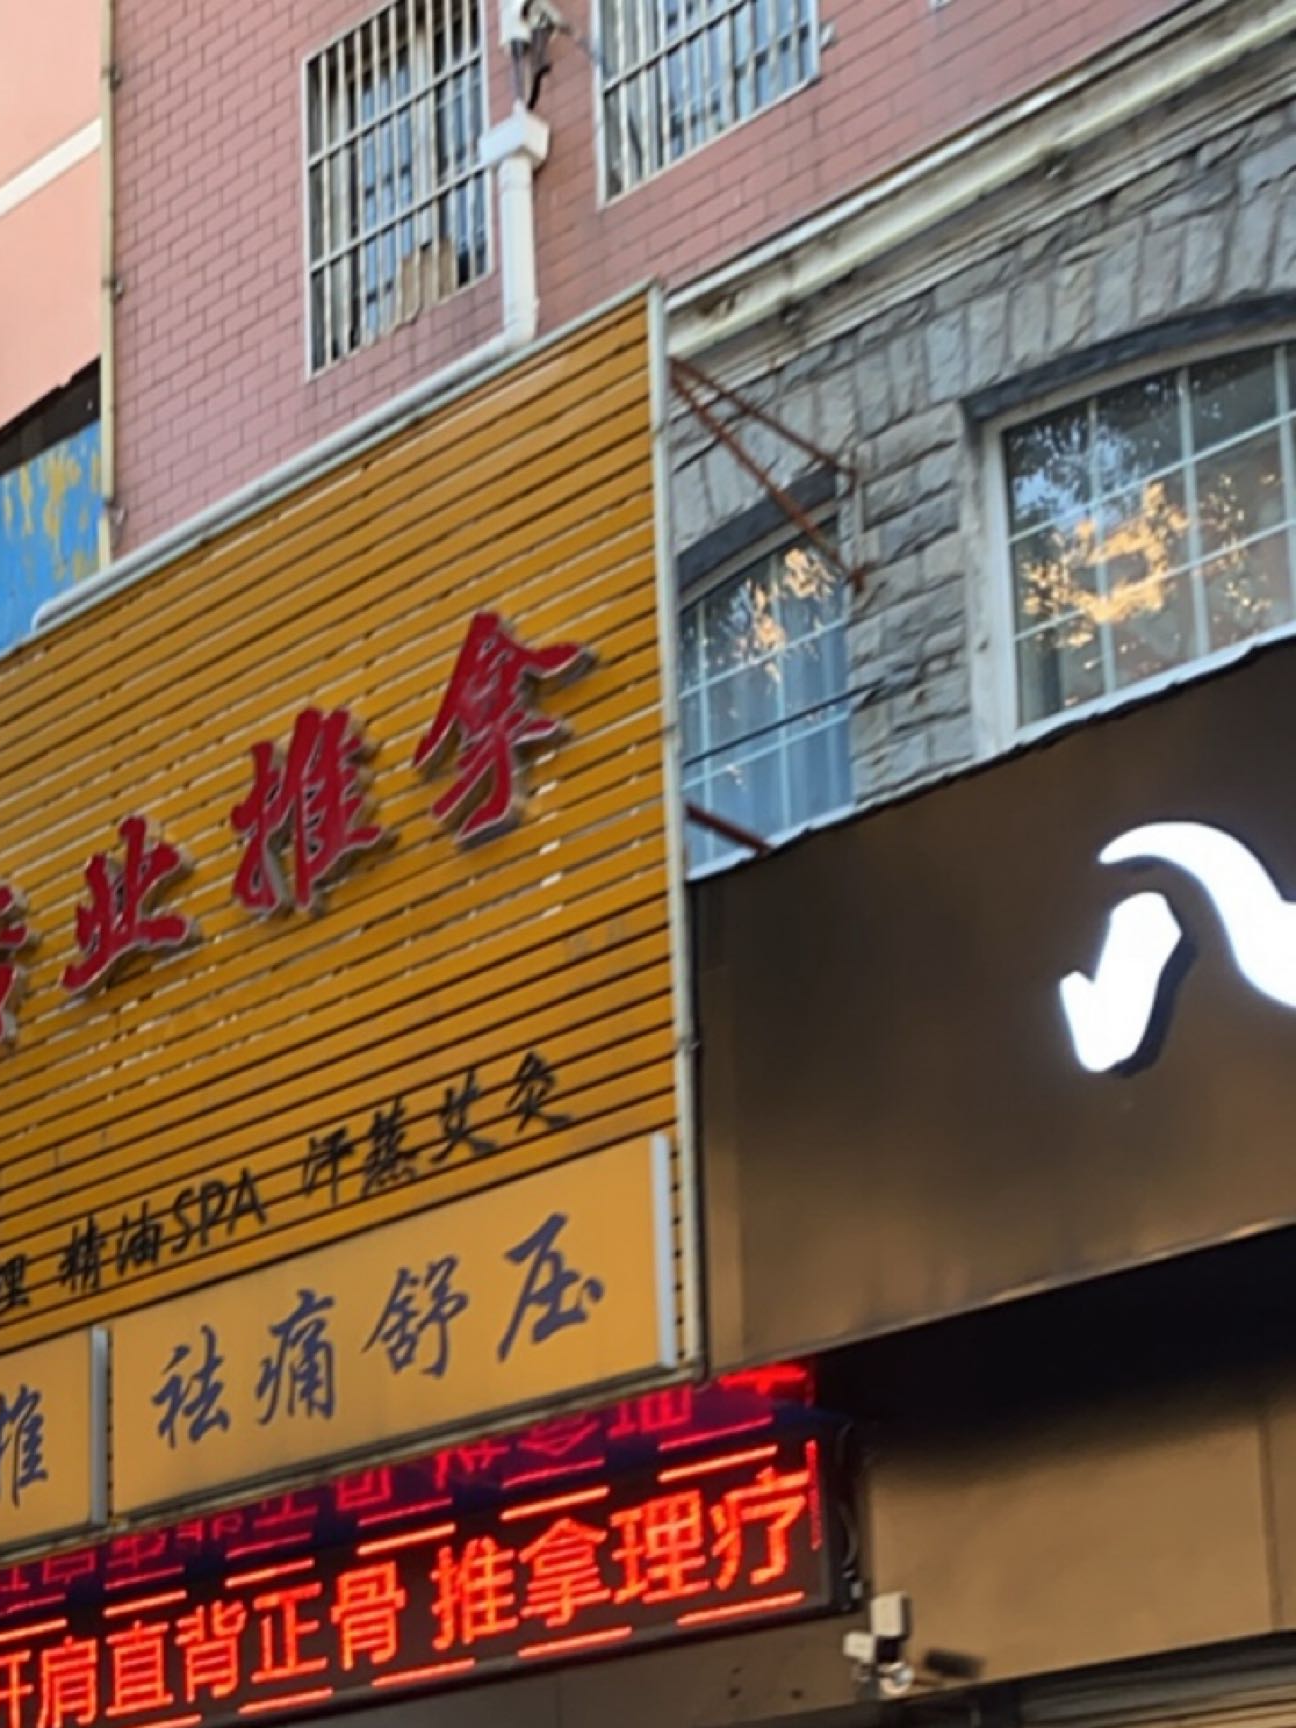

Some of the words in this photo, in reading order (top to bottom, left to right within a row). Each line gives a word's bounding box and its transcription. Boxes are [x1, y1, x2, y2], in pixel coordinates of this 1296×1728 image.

[152, 1212, 605, 1452] 祛痛舒压
[431, 1465, 811, 1651] 推拿理疗
